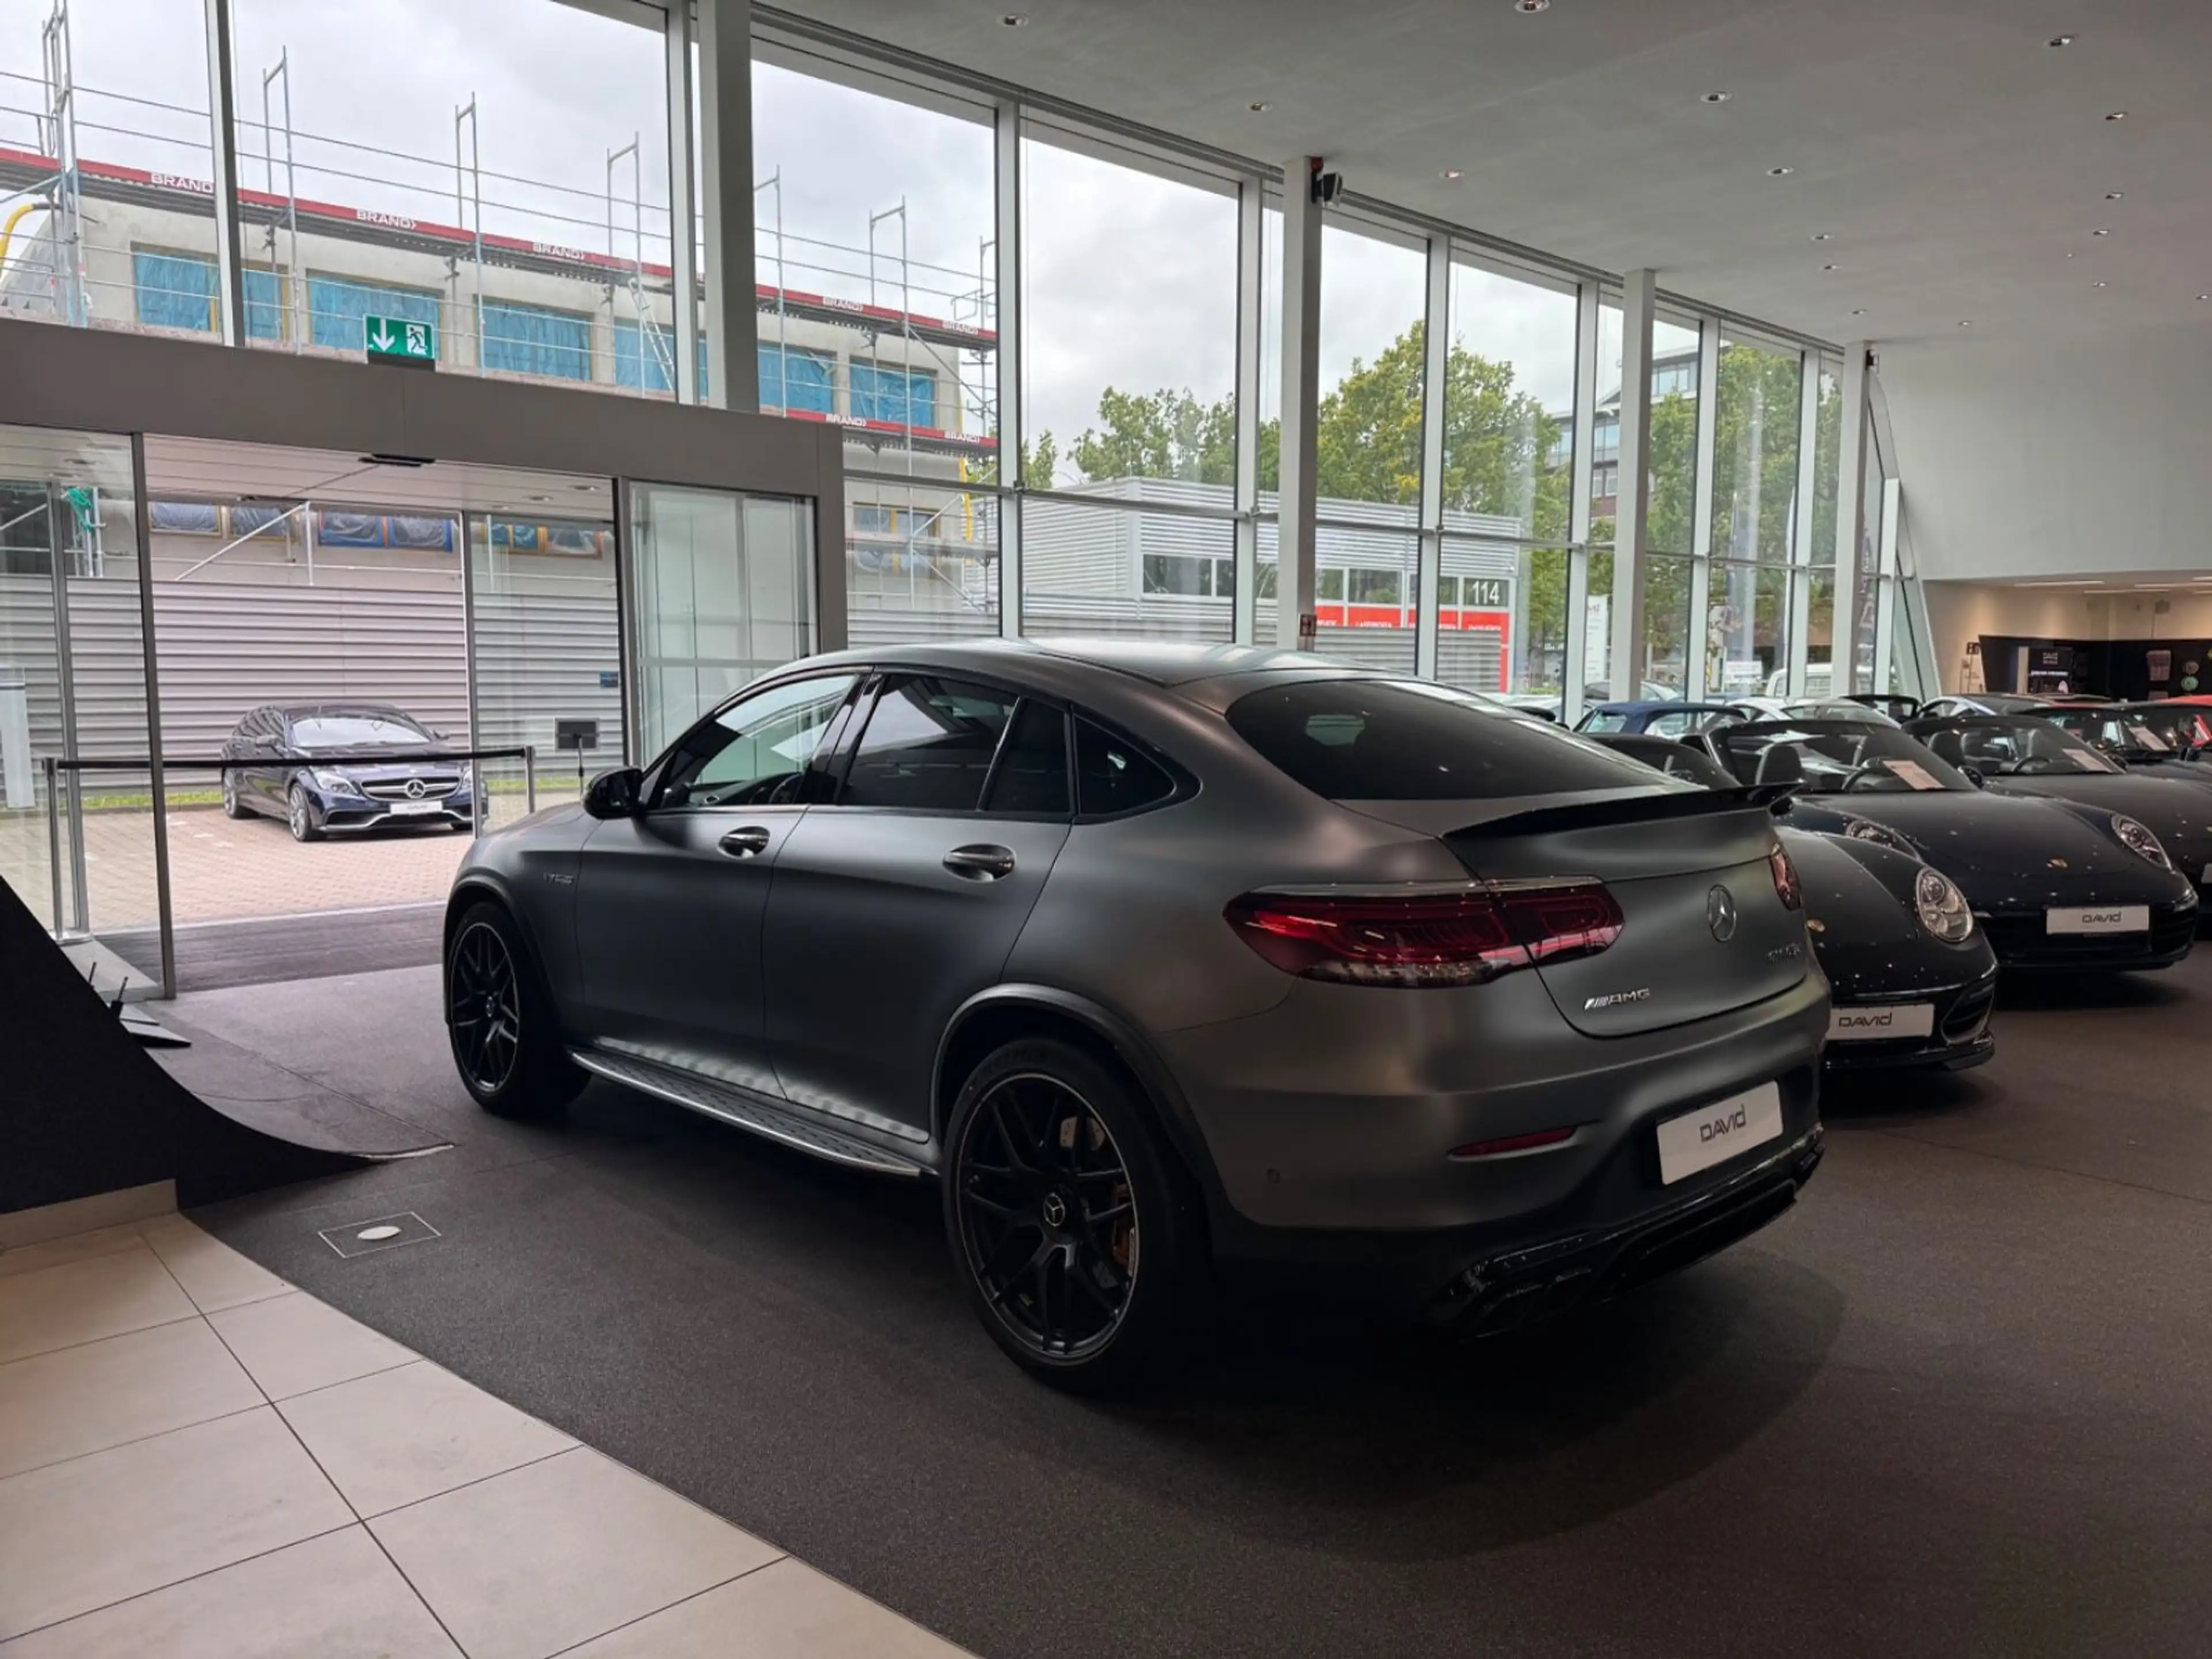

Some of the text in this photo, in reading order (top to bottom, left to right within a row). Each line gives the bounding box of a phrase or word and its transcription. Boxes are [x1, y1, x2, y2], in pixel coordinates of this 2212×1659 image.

[151, 173, 214, 194] BRAND
[357, 209, 411, 228] BRAND
[533, 242, 580, 259] BRAND
[1472, 580, 1500, 604] 114
